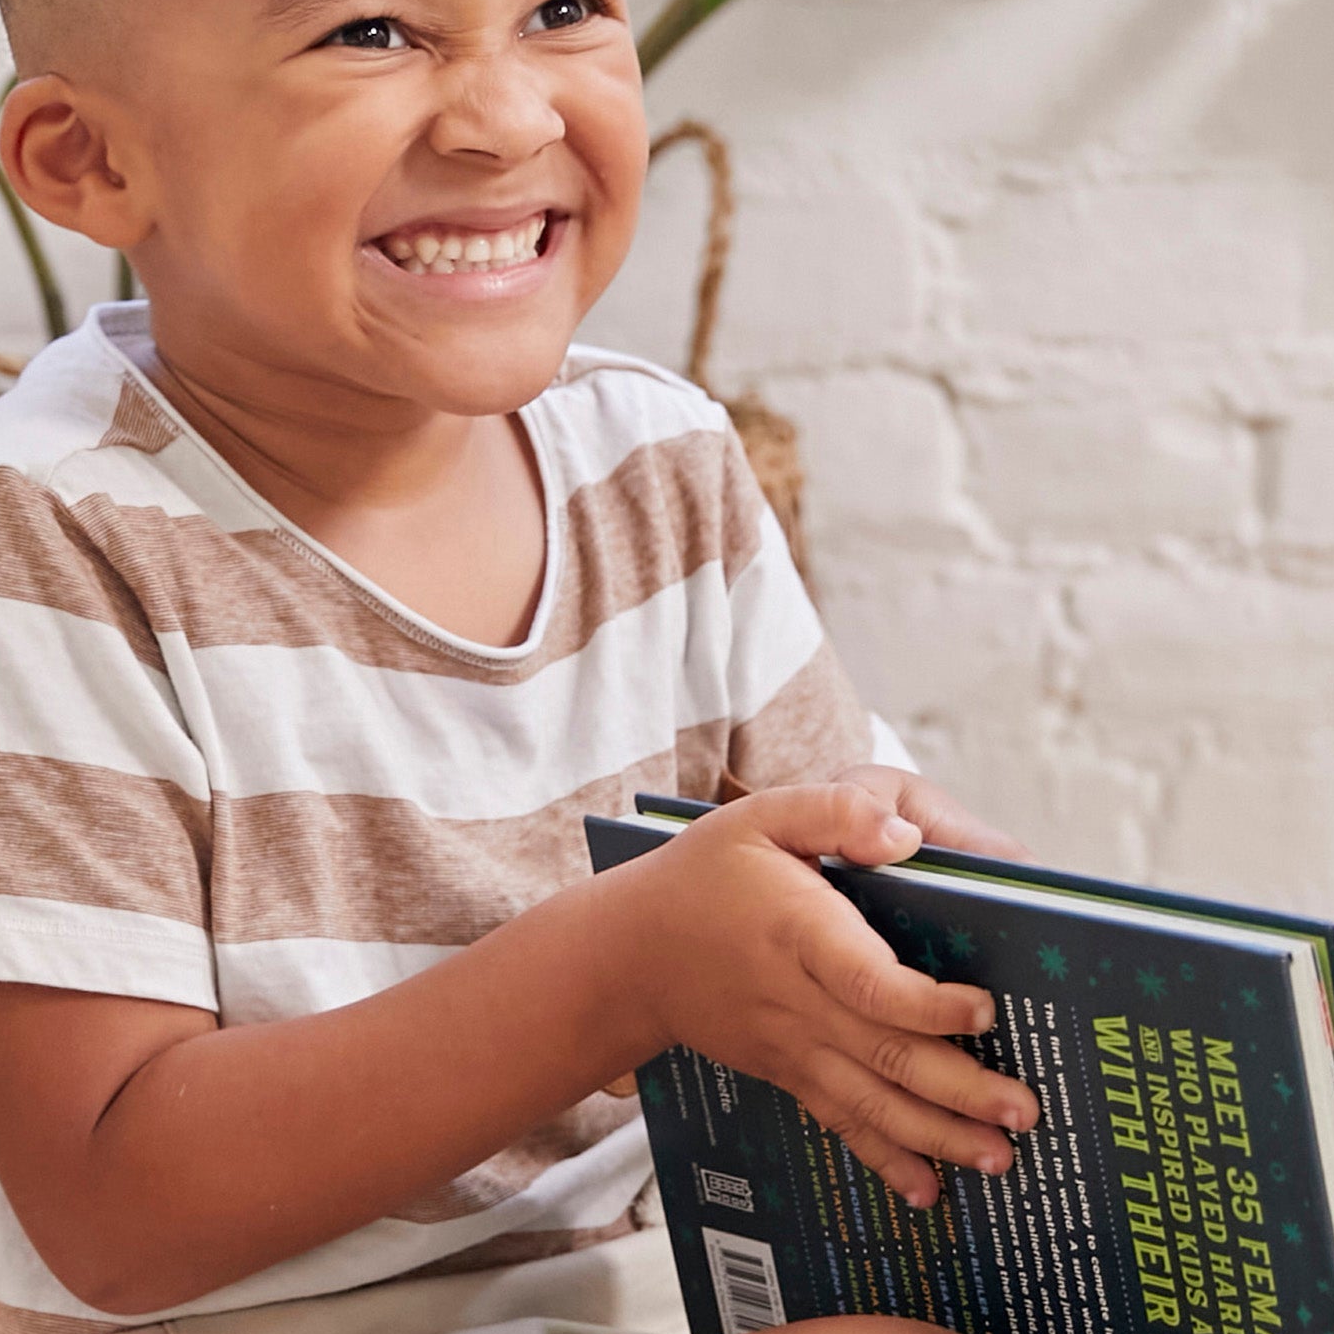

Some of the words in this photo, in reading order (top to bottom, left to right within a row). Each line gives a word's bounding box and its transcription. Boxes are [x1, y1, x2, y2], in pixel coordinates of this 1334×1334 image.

[1002, 992, 1029, 1084] snowboarde
[1022, 996, 1036, 1026] one
[1042, 1000, 1057, 1030] The
[992, 1037, 1003, 1057] an
[1028, 1032, 1046, 1078] tennis
[1049, 1035, 1064, 1067] first
[1137, 1023, 1163, 1064] AND
[1167, 1025, 1205, 1106] WHO
[711, 1061, 734, 1115] chette
[1036, 1083, 1056, 1131] player
[1055, 1071, 1073, 1126] woman
[1090, 1008, 1150, 1155] WITH
[1200, 1034, 1253, 1158] MEET
[803, 1139, 817, 1168] JEN
[1027, 1127, 1046, 1180] landed
[1048, 1135, 1060, 1151] in
[1051, 1156, 1066, 1182] the
[1066, 1132, 1084, 1175] horse
[1144, 1071, 1193, 1224] INSPIRED
[809, 1169, 829, 1227] WELTER
[1022, 1199, 1032, 1210] a
[1037, 1181, 1046, 1192] a
[1073, 1178, 1093, 1229] jockey
[1182, 1113, 1229, 1245] PLAYED
[1223, 1164, 1264, 1226] 35
[820, 1137, 838, 1186] MYERS
[830, 1187, 850, 1243] TAYLOR
[844, 1257, 864, 1314] MARIAN
[838, 1140, 854, 1183] ONDA
[847, 1185, 867, 1243] ROUSEY
[862, 1258, 880, 1307] WILMA
[1057, 1186, 1075, 1234] world.
[823, 1240, 843, 1297] SERENA
[864, 1181, 885, 1241] PATRICK
[879, 1255, 898, 1308] MEGAN
[882, 1184, 902, 1240] UMANN
[896, 1254, 915, 1306] NANCY
[923, 1206, 941, 1256] PARZA
[935, 1269, 950, 1303] LISA
[938, 1192, 957, 1244] CRUMP
[951, 1258, 969, 1308] SASHA
[953, 1176, 977, 1254] GRETCHEN
[969, 1256, 989, 1316] BLEILER
[988, 1226, 1007, 1267] using
[998, 1269, 1014, 1304] their
[1013, 1248, 1025, 1268] on
[1024, 1213, 1048, 1283] ballerina,
[1039, 1193, 1069, 1299] death-defying
[1067, 1239, 1079, 1252] A
[1085, 1234, 1098, 1253] to
[1117, 1164, 1182, 1330] THEIR
[1173, 1230, 1209, 1309] KIDS
[908, 1222, 926, 1273] JACKIE
[918, 1275, 936, 1324] JOYNE
[1017, 1270, 1032, 1295] the
[1038, 1286, 1054, 1315] and
[1070, 1256, 1089, 1301] surfer
[1088, 1255, 1112, 1321] compete
